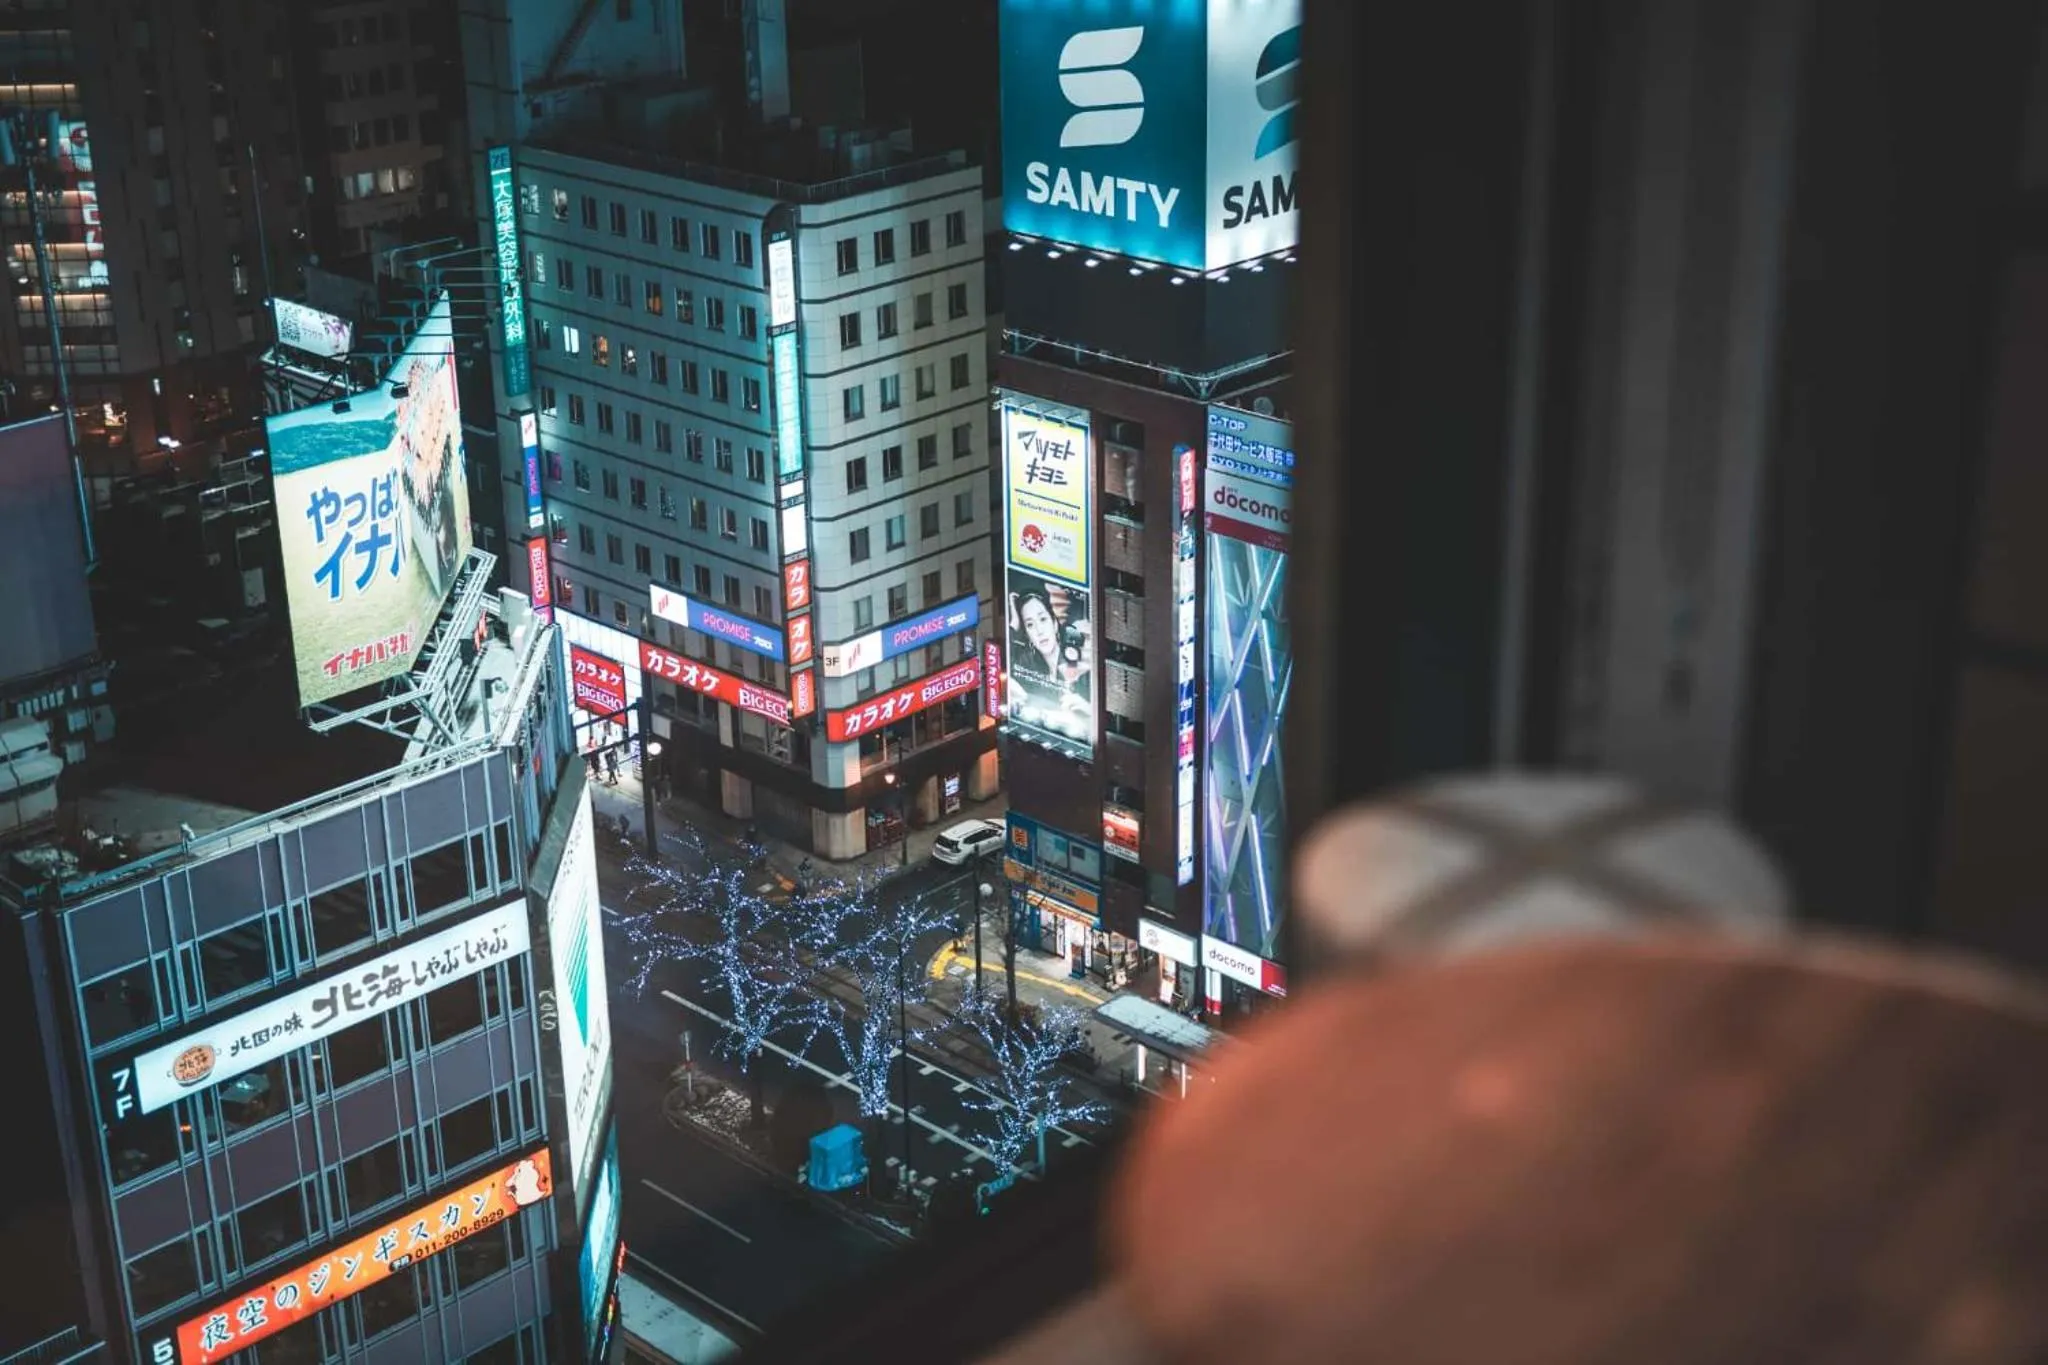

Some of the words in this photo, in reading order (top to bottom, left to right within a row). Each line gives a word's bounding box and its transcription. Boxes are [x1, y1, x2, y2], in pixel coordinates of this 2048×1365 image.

[1026, 161, 1180, 229] SAMTY
[1209, 414, 1247, 431] C-TOP
[1017, 429, 1076, 461] マツモト
[1025, 458, 1068, 486] キヨシ
[1213, 485, 1292, 524] docomo
[703, 611, 752, 643] PROMISE
[893, 615, 945, 646] PROMISE
[575, 658, 622, 687] カラオケ
[647, 650, 720, 692] カラオケ
[825, 656, 840, 667] 3F
[845, 691, 915, 737] カラオケ
[1208, 949, 1256, 977] docomo
[230, 1011, 304, 1058] 北国の味
[415, 1208, 505, 1259] 011-200-8929
[201, 1184, 492, 1351] 夜空のジンギスカン
[152, 1337, 174, 1365] 5
